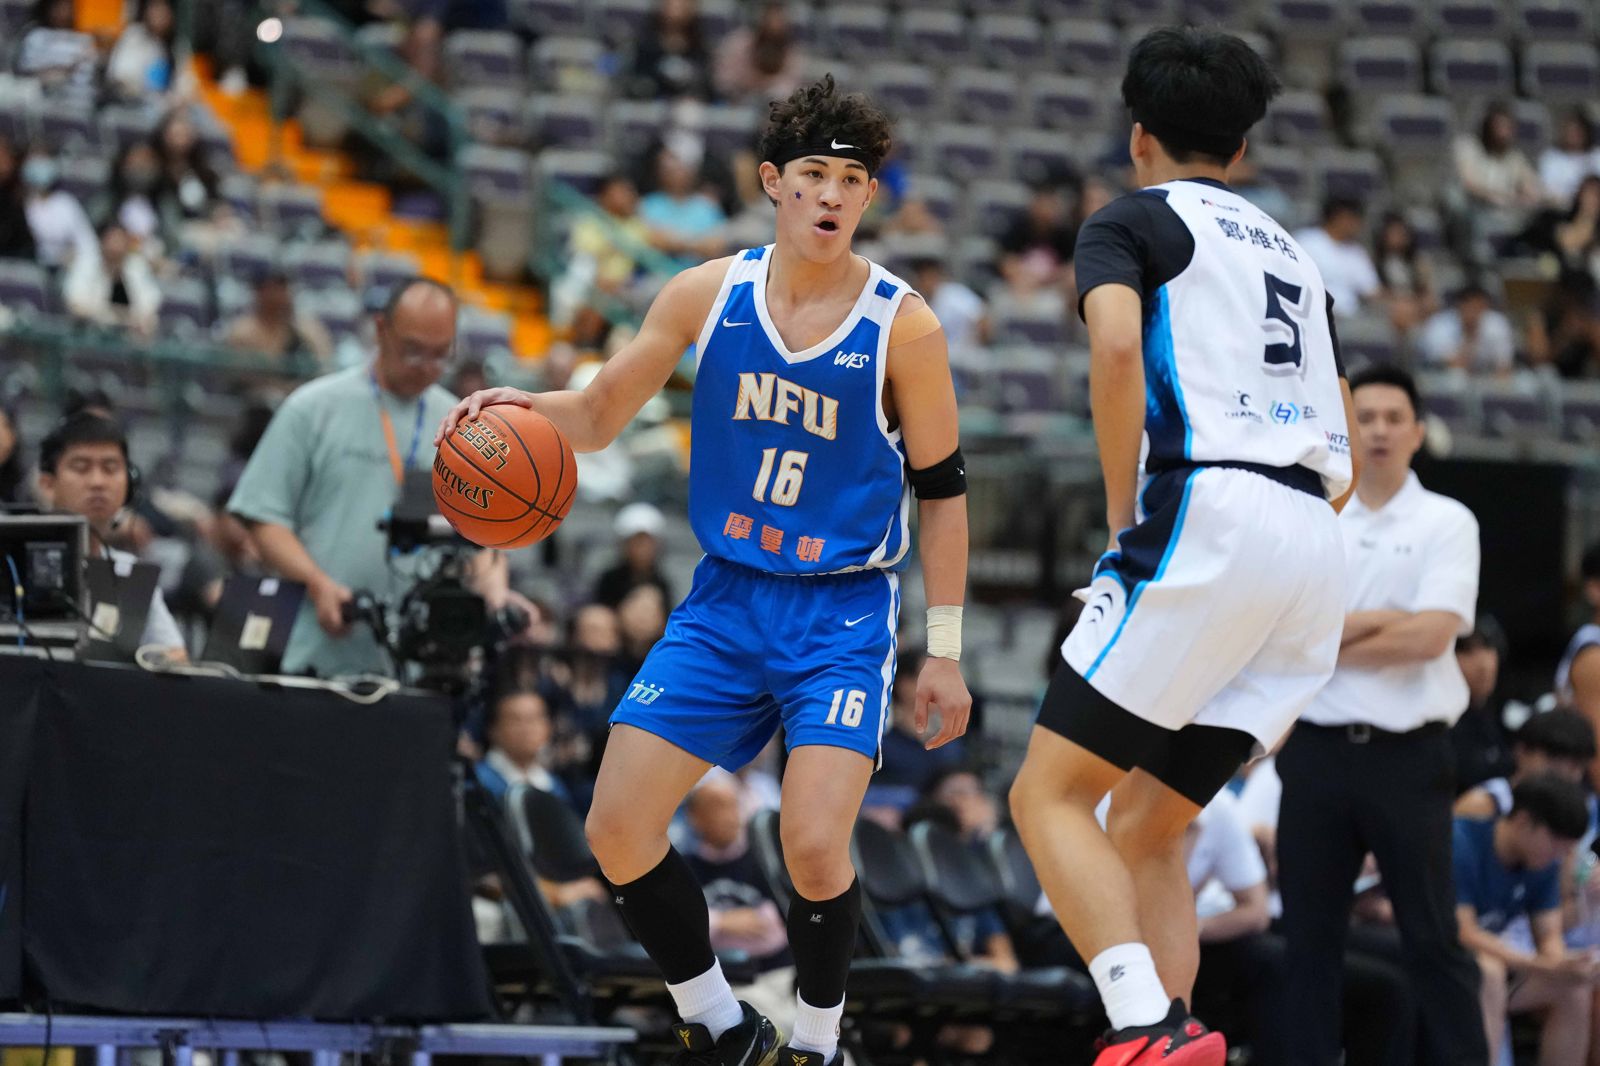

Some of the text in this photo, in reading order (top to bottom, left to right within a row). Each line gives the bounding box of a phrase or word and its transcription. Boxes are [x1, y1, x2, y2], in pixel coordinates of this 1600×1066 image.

[1214, 217, 1299, 263] 鄭維佑
[1262, 270, 1304, 369] 5
[833, 350, 870, 369] WES
[732, 372, 839, 441] NFU
[434, 448, 494, 509] SPALDIN
[752, 447, 809, 507] 16
[723, 512, 826, 562] 摩曼頓
[824, 688, 867, 728] 16
